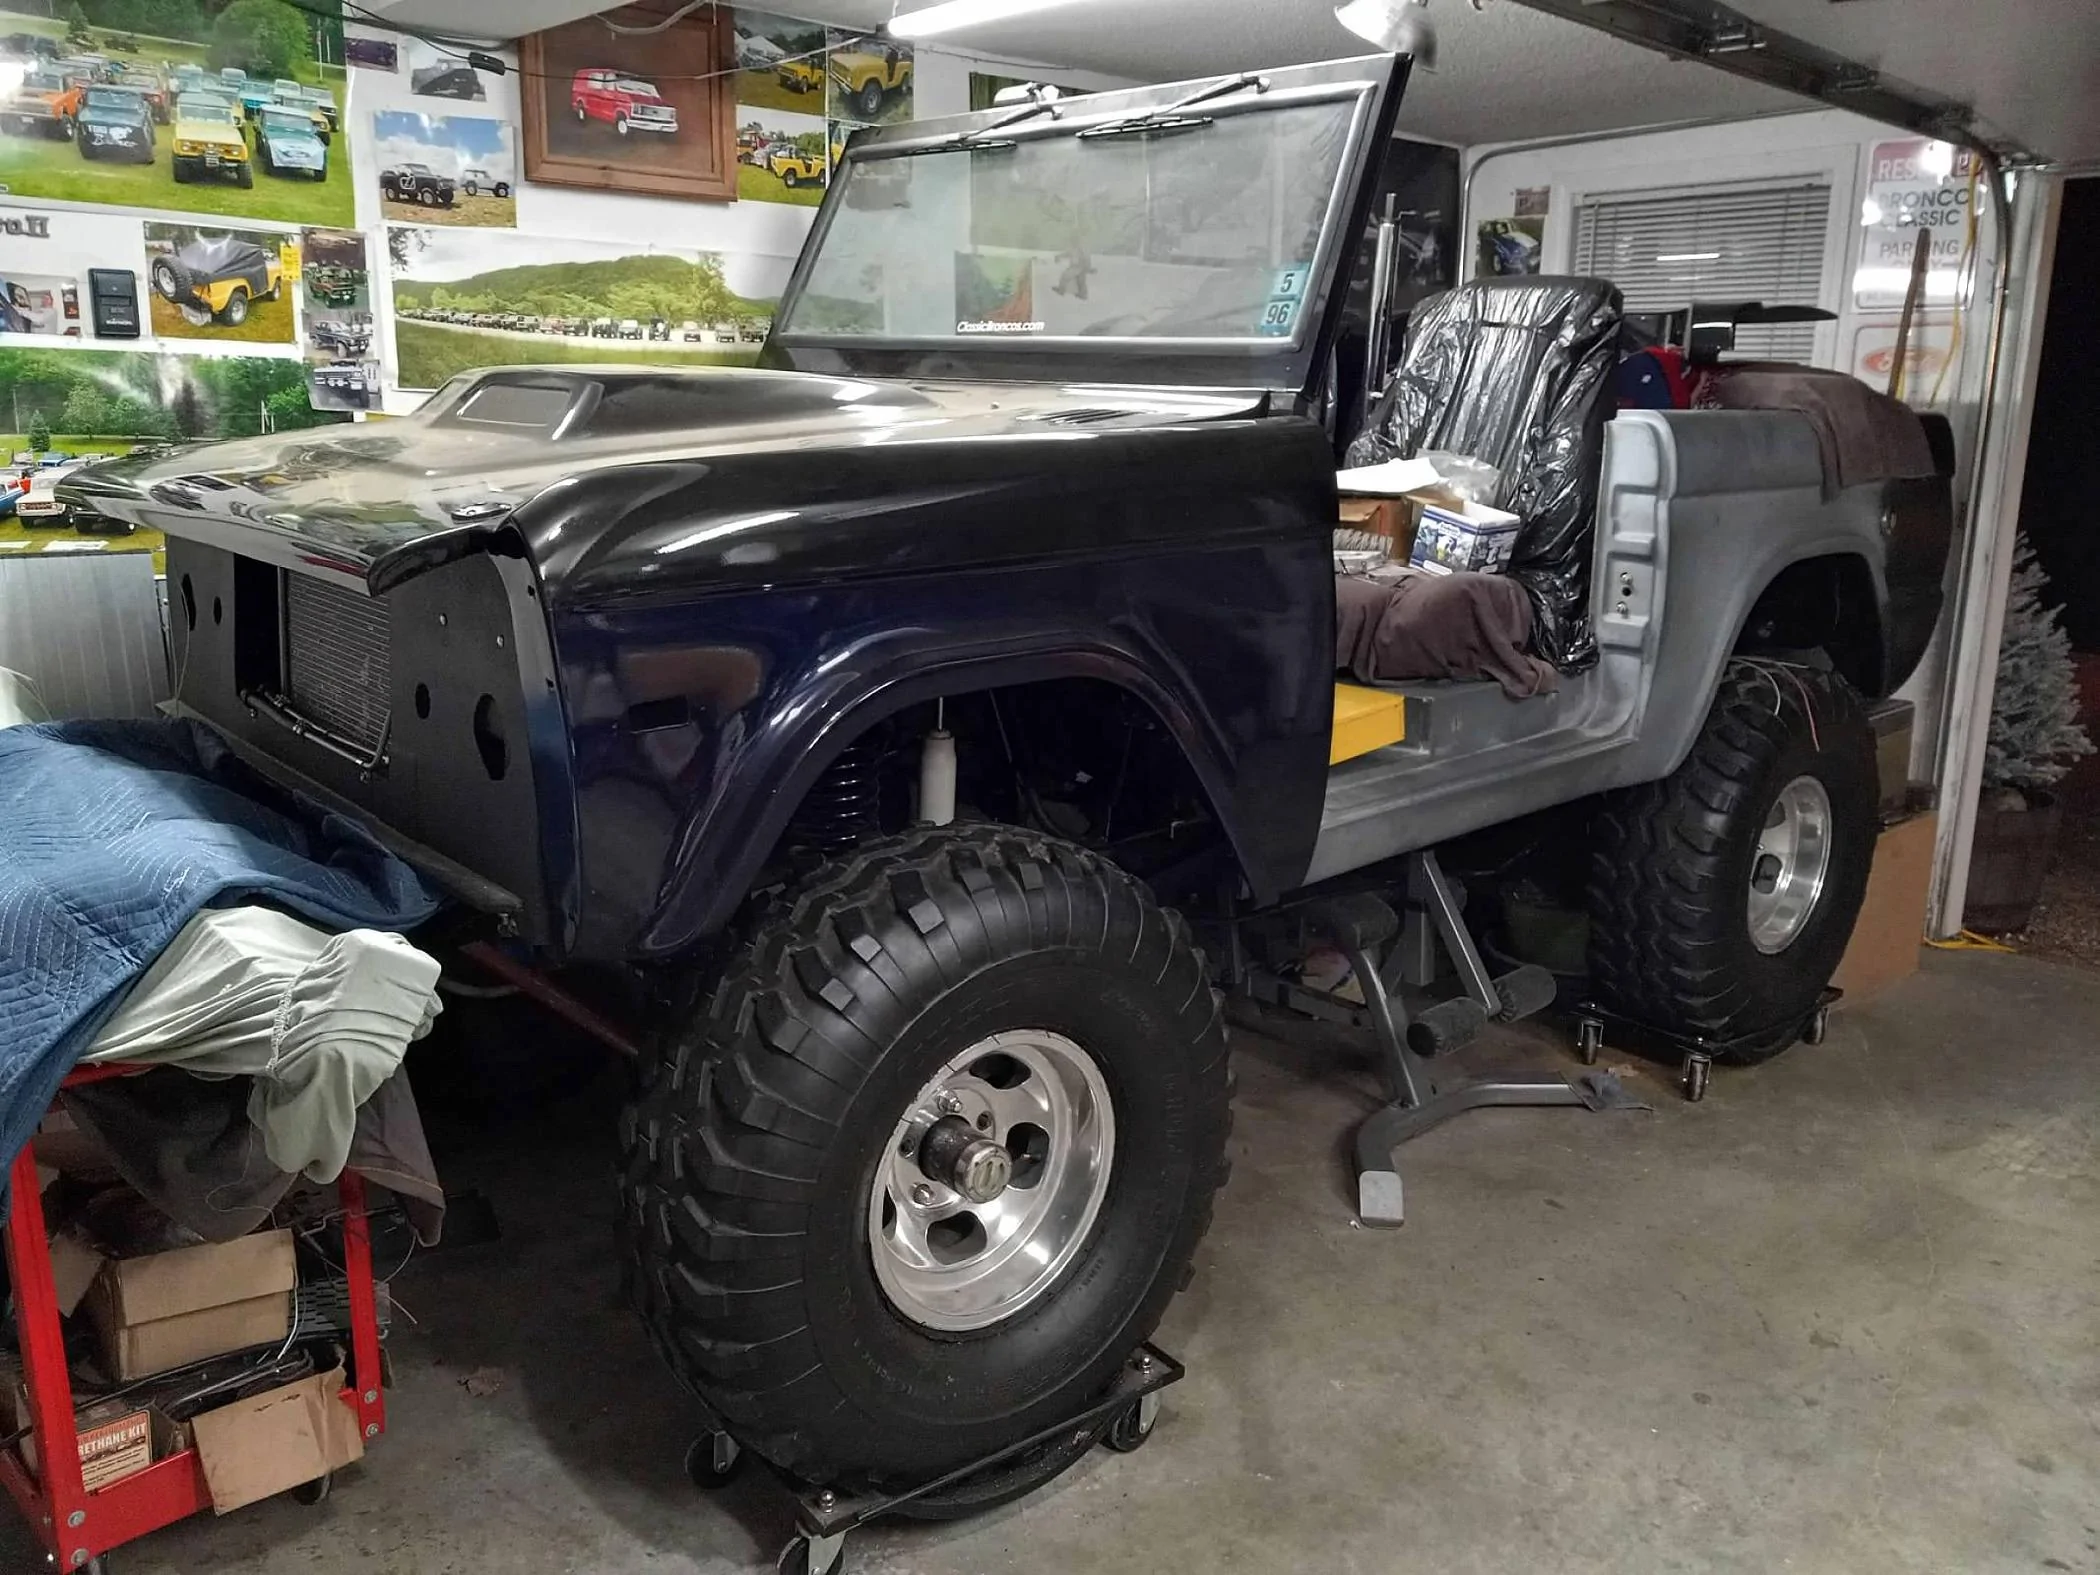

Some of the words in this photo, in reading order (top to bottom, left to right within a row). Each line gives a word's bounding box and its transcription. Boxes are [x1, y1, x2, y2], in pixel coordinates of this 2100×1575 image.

[1880, 239, 1959, 259] PARNG
[1280, 272, 1295, 293] 5
[1266, 303, 1290, 324] 96
[78, 1430, 127, 1456] RETHANE
[128, 1422, 147, 1438] KIT
